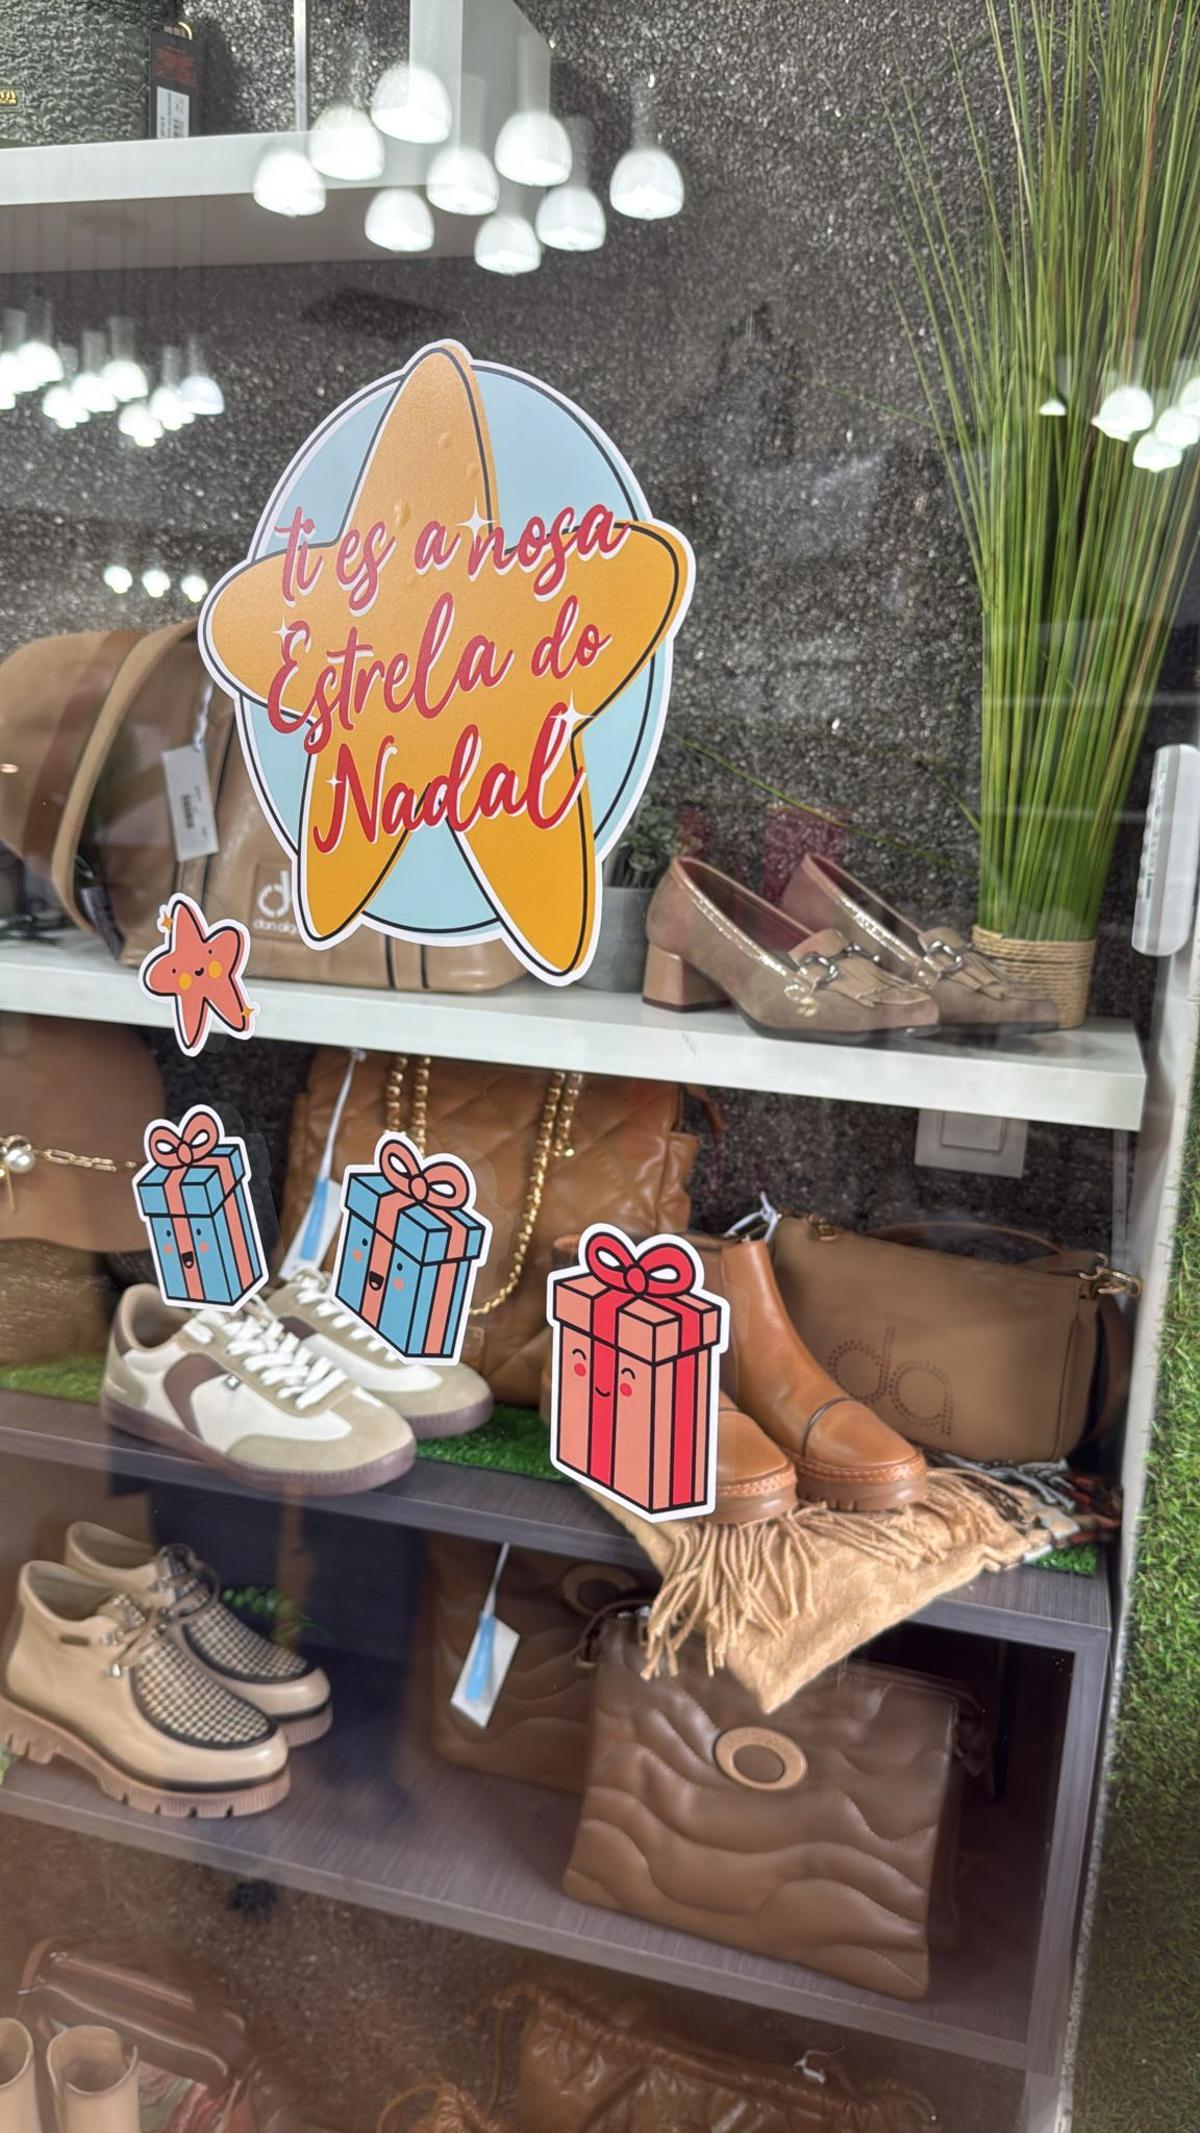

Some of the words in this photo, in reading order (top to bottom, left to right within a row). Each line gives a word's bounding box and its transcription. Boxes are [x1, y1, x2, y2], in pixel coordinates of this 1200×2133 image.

[275, 507, 323, 603] ti
[336, 521, 396, 613] es
[414, 521, 461, 574] a
[467, 503, 631, 598] nosa
[267, 592, 514, 754] Estrela
[531, 595, 612, 680] do
[313, 702, 585, 854] Nadal
